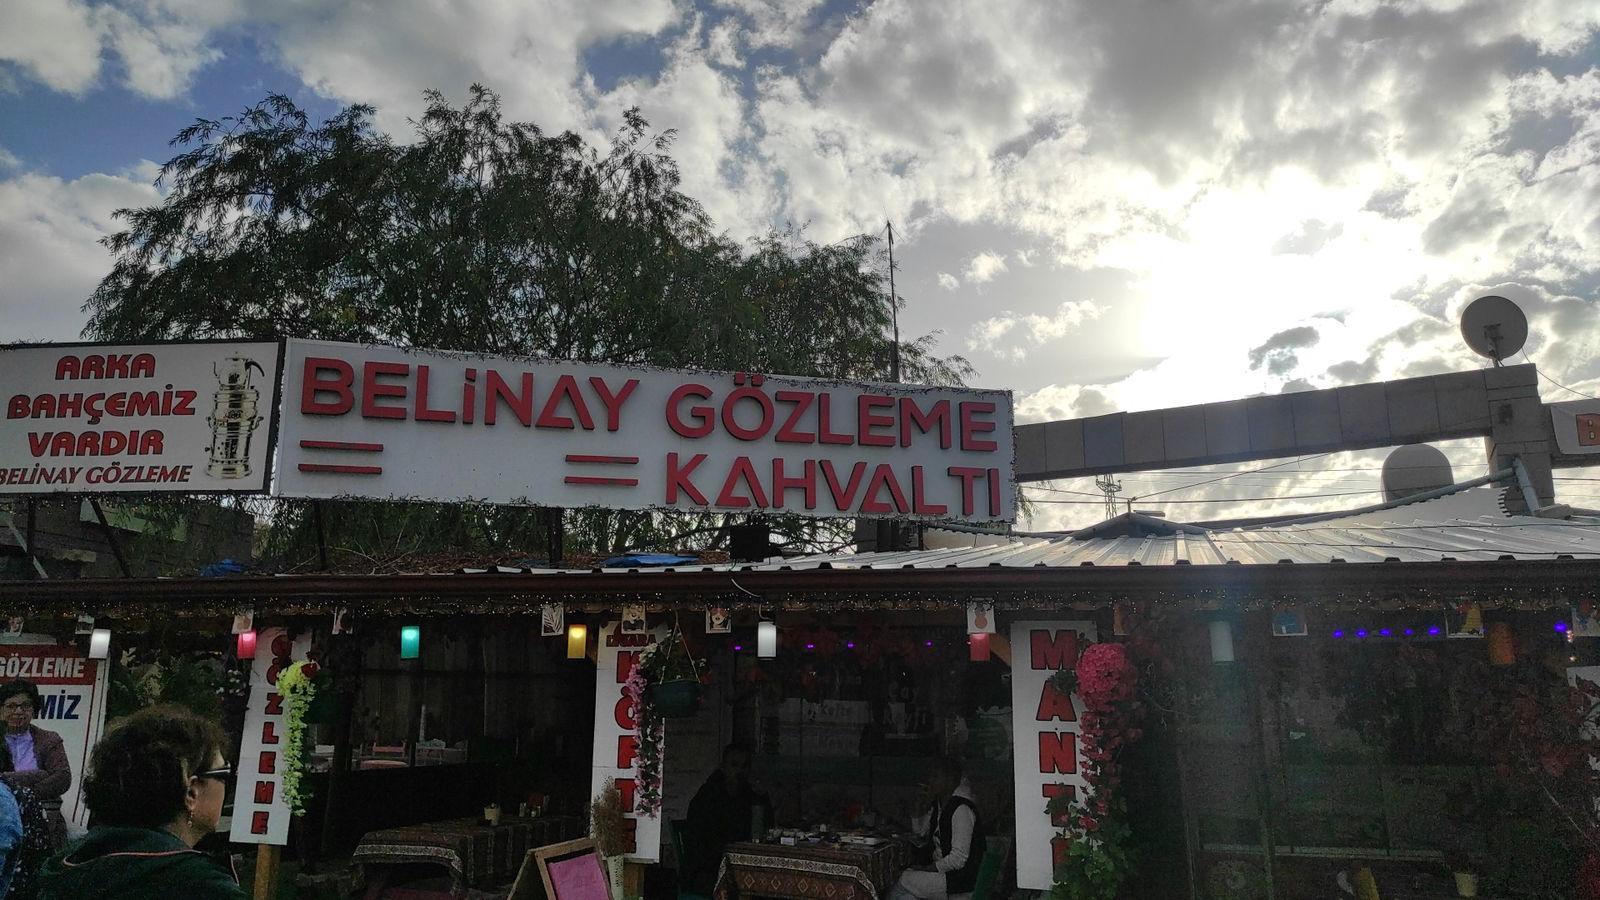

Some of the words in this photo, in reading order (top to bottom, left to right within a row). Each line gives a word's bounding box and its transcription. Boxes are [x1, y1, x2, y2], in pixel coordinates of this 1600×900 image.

[55, 353, 156, 380] ARKA
[7, 383, 198, 425] BAHÇEMİZ
[665, 373, 997, 451] GÖZLEME
[28, 430, 164, 457] VARDIR
[86, 461, 193, 484] GÖZLEME
[665, 452, 1001, 516] KAHVALTI
